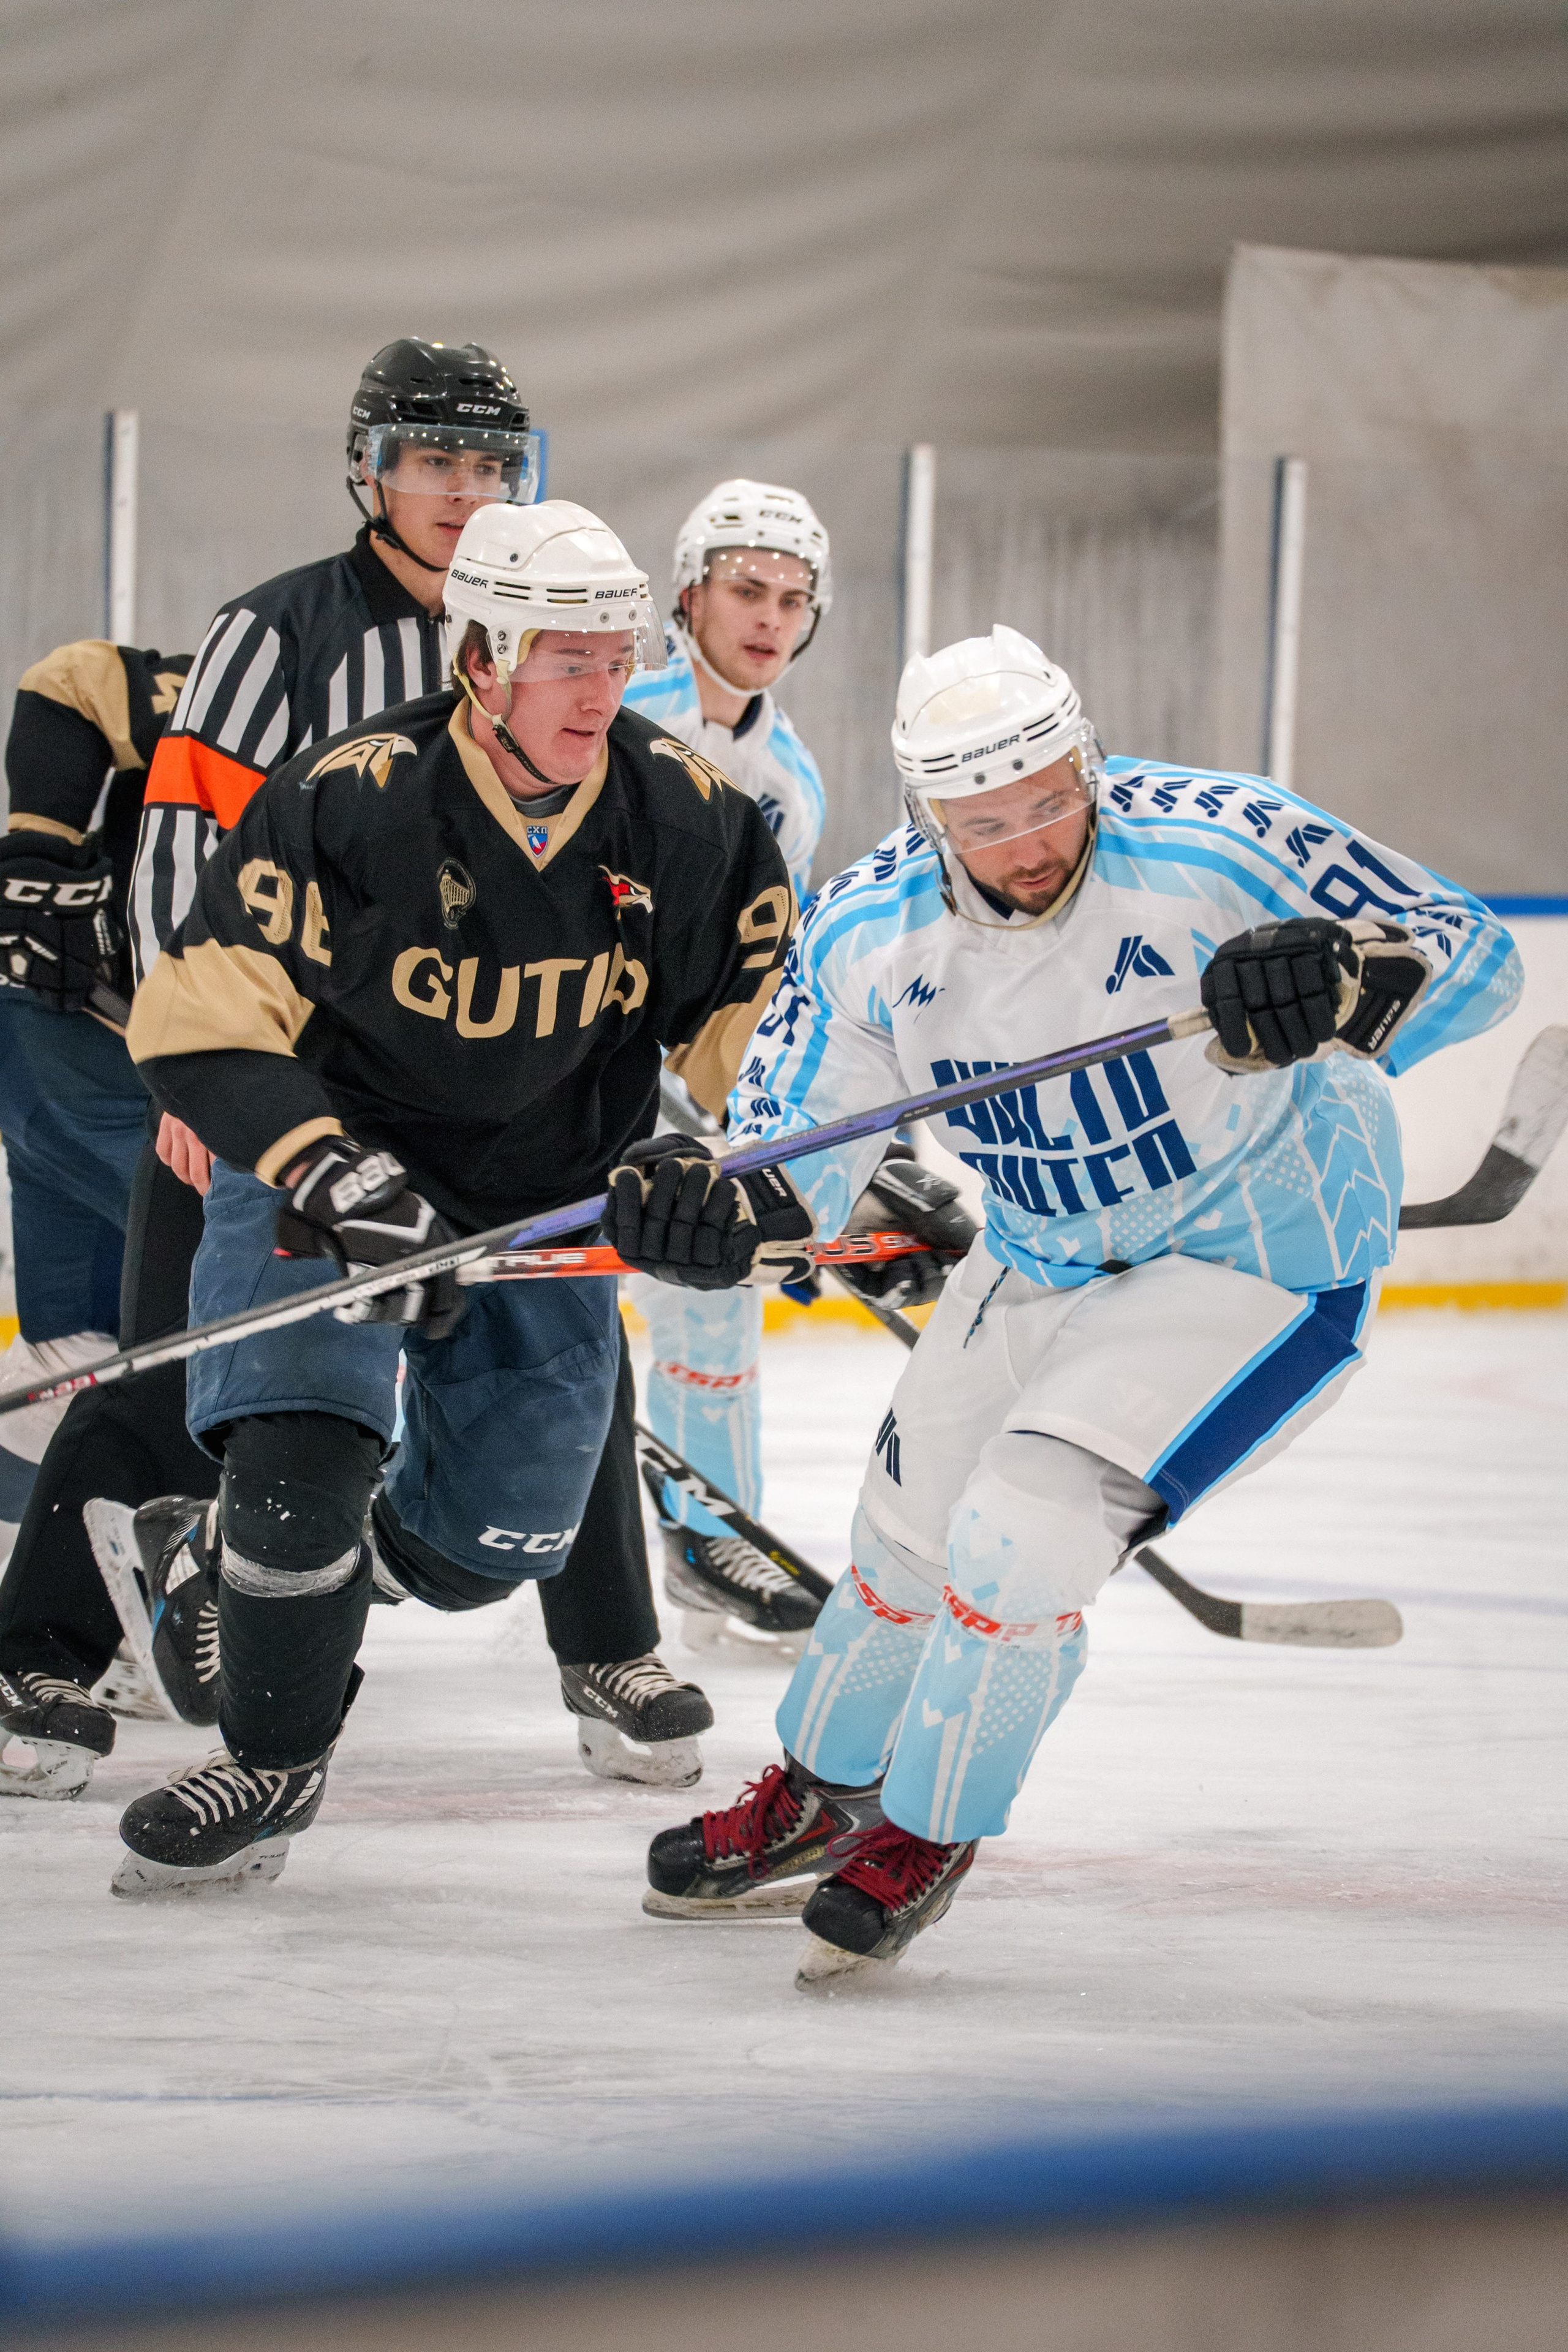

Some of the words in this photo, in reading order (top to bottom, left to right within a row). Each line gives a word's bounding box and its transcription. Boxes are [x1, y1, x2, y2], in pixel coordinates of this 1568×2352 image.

[353, 405, 371, 420] CCM
[456, 403, 501, 416] CCM
[1310, 839, 1424, 918] 91
[762, 1168, 788, 1197] UER
[583, 1685, 619, 1718] CCM
